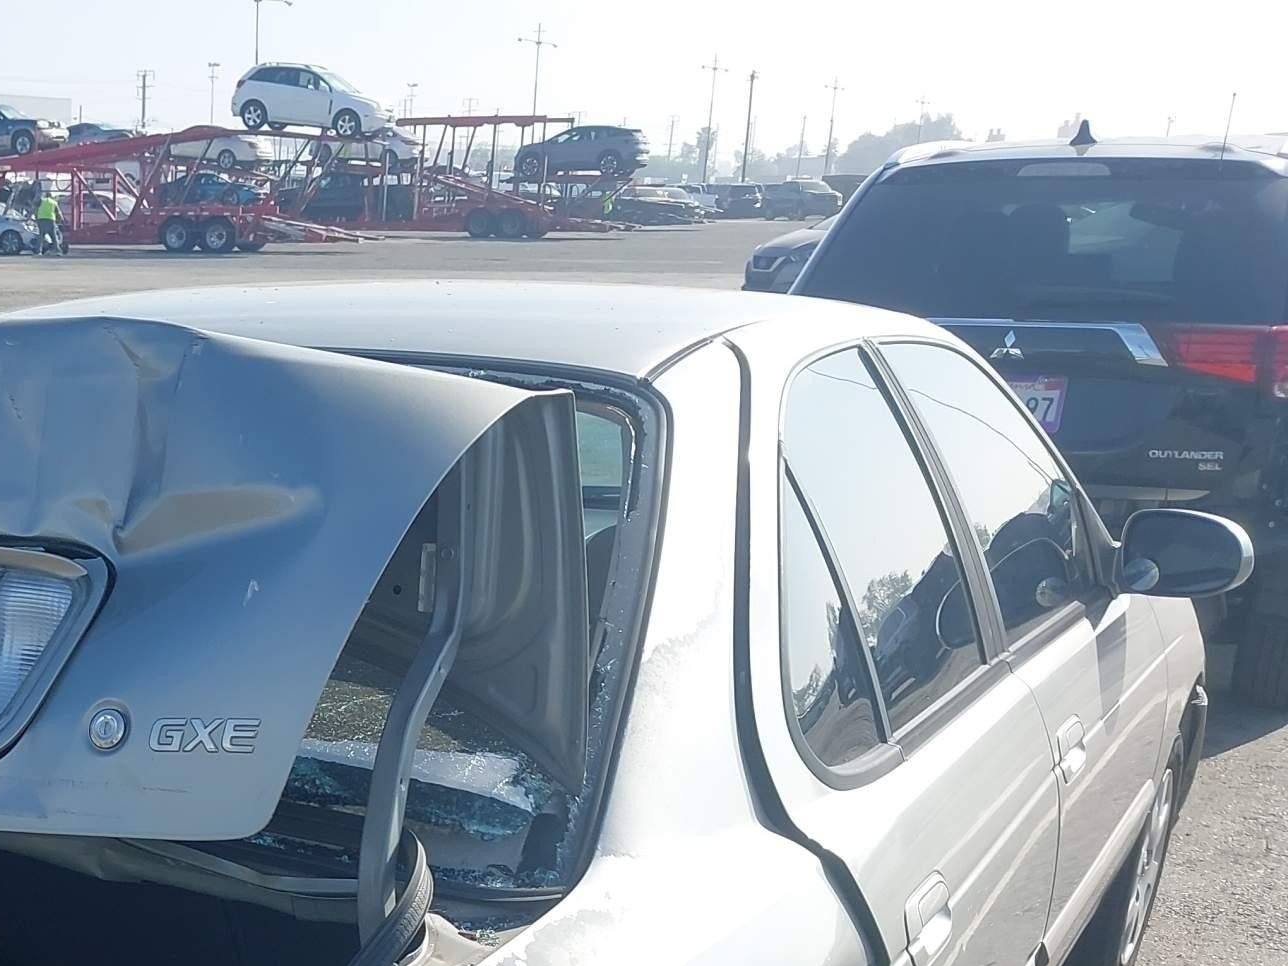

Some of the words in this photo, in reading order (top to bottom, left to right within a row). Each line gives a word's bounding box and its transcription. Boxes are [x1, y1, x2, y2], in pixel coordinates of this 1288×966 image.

[1148, 449, 1224, 460] OUTLANDER
[1197, 462, 1223, 471] SEL
[148, 718, 262, 753] GXE
